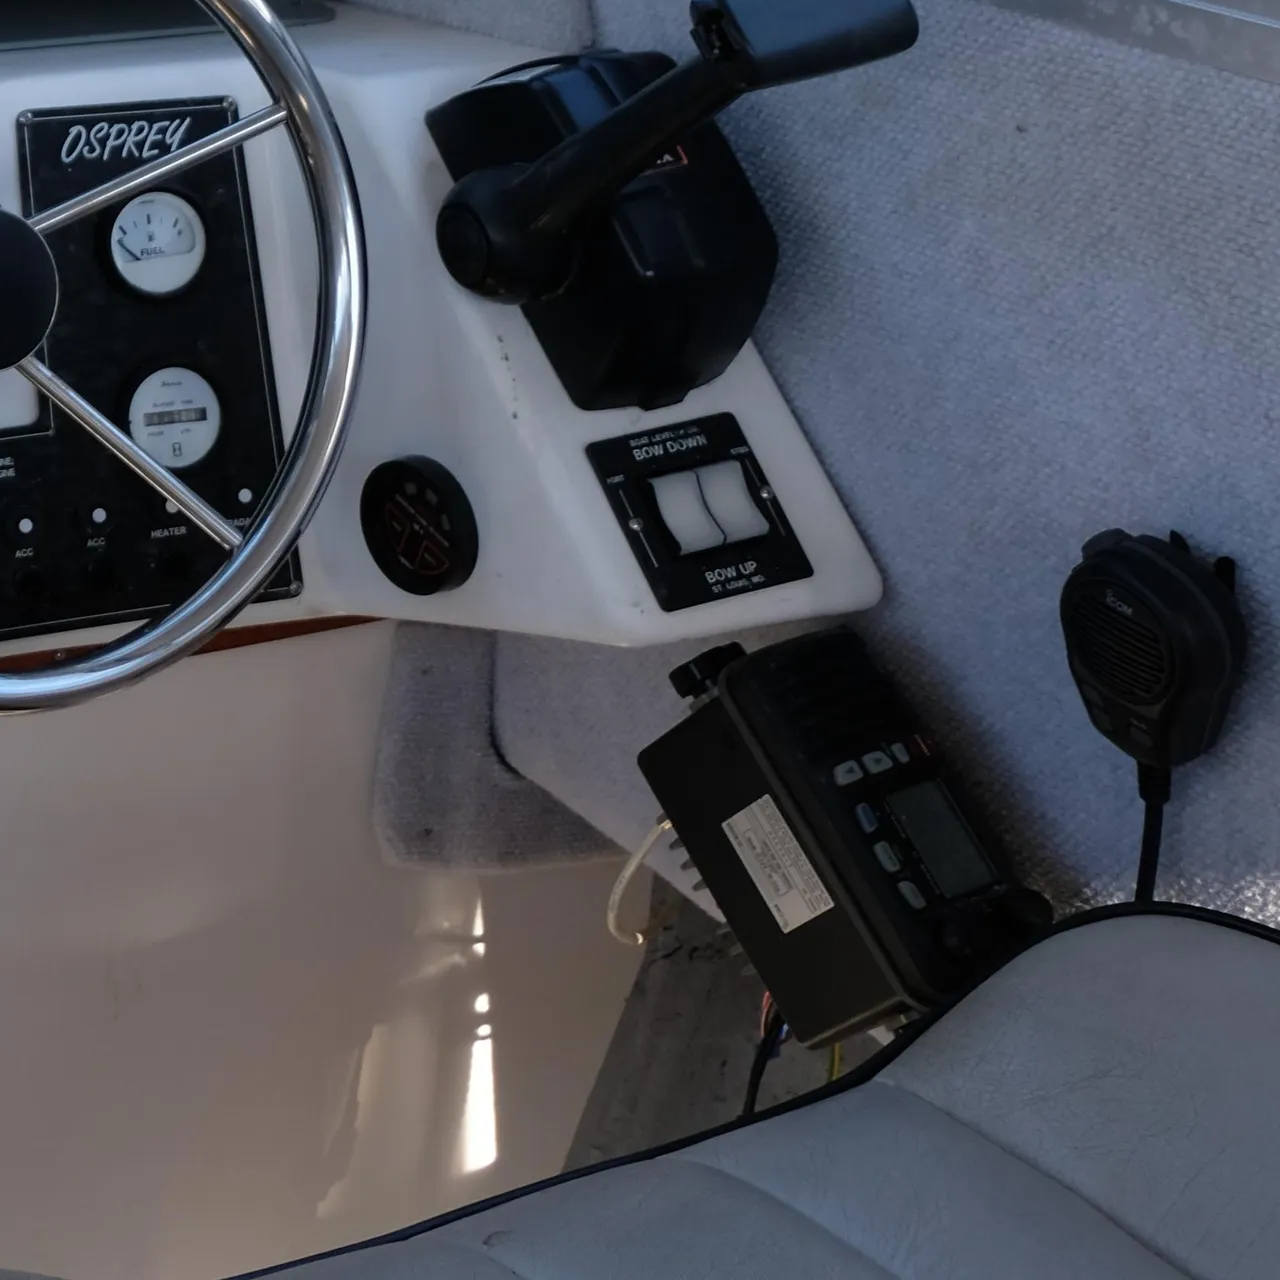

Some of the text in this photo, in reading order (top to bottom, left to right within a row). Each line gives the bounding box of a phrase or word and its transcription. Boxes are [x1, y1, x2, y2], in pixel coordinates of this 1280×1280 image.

[61, 117, 190, 163] OSPREY
[140, 246, 164, 256] FUEL
[633, 434, 708, 460] BOW DOWN
[150, 525, 187, 539] HEATER
[86, 536, 106, 548] ACC
[14, 547, 34, 559] ACC
[705, 561, 757, 583] BOW UP
